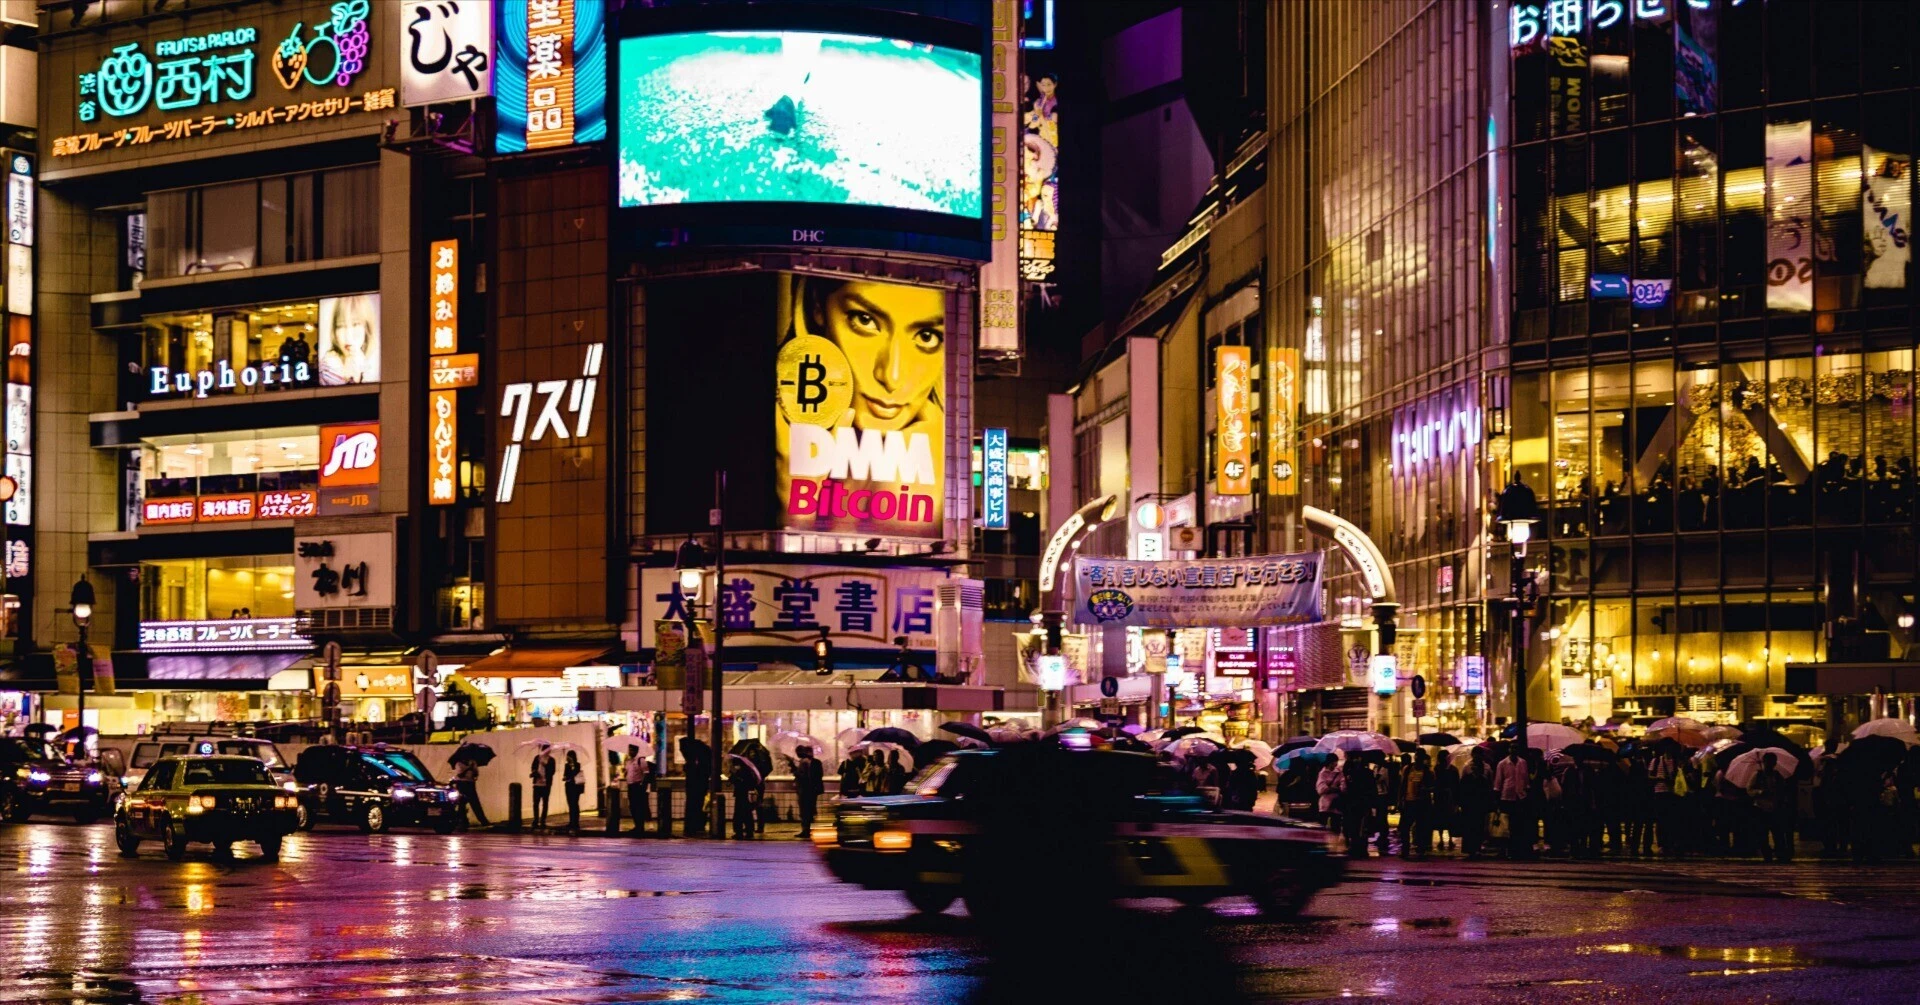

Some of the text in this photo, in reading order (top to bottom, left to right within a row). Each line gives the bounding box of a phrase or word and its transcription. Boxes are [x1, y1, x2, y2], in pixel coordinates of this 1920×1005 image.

[156, 27, 255, 56] FRUITS&PARLOR
[1508, 0, 1746, 47] お知ら
[408, 1, 488, 91] じゃ
[79, 73, 96, 122] 渋谷
[154, 48, 255, 111] 西村
[792, 229, 824, 243] DHC
[149, 355, 310, 398] Euphoria
[323, 432, 378, 477] JTB
[789, 423, 937, 486] DMM
[1224, 461, 1245, 477] 4F
[146, 501, 194, 520] 国内旅行
[201, 498, 252, 517] 海外旅行
[263, 493, 311, 506] ハネムーン
[350, 494, 369, 507] JTB
[788, 479, 935, 523] Bitcoin
[656, 578, 935, 635] 大盛堂書店
[1624, 682, 1742, 696] STARBUCKS COFFEE
